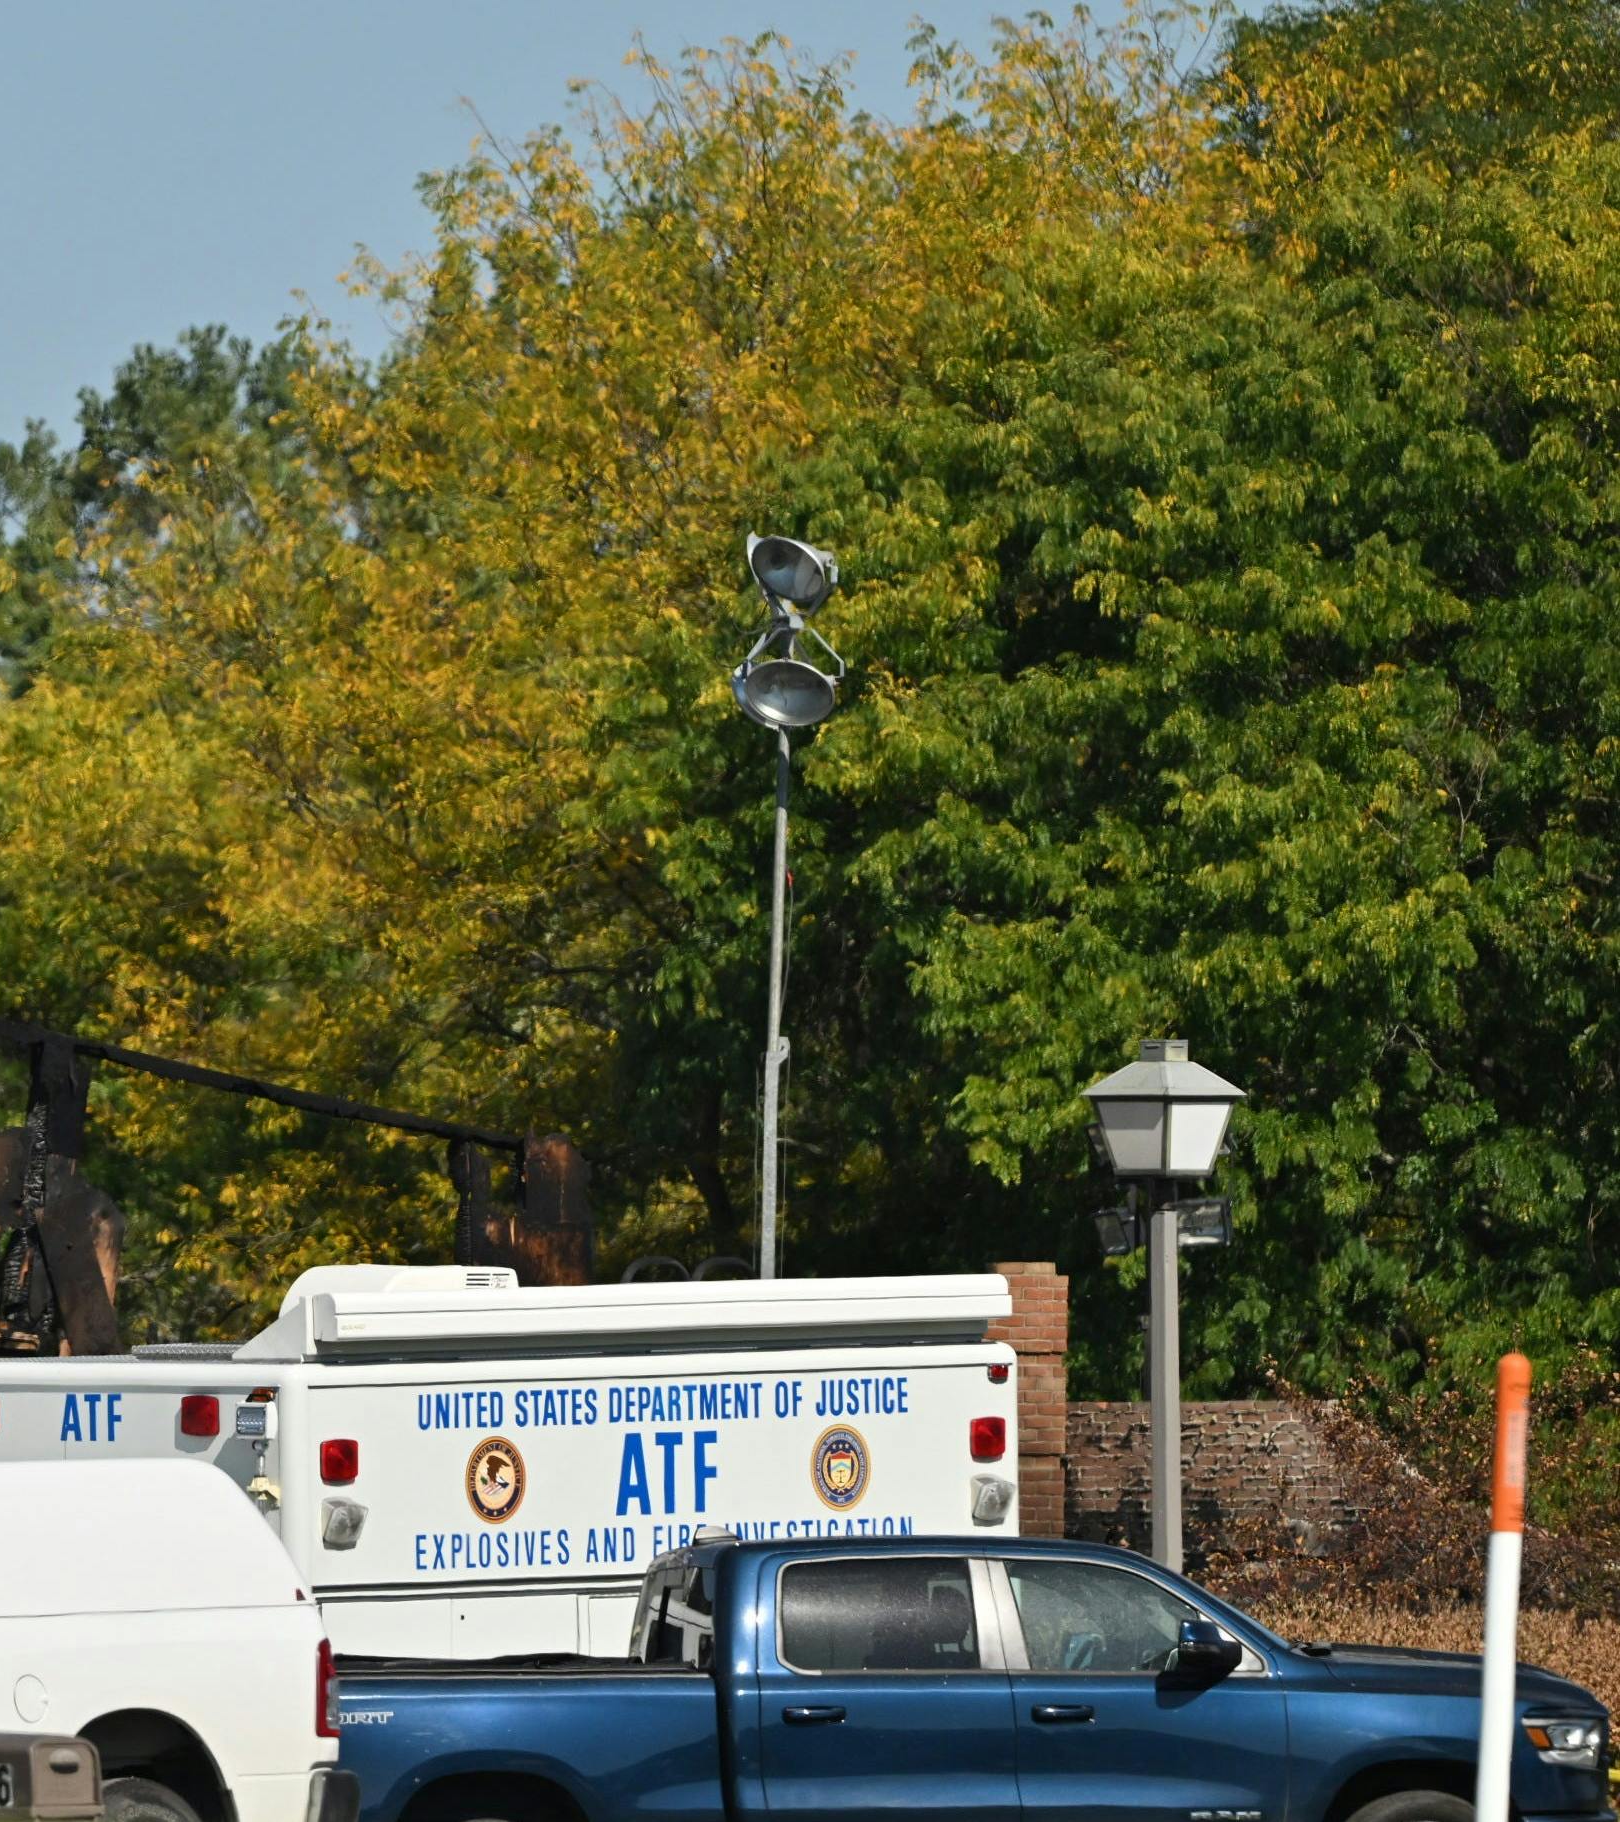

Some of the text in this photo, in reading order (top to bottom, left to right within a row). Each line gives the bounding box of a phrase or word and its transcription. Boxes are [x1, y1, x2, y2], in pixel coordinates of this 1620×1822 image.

[60, 1393, 122, 1441] ATF
[417, 1376, 909, 1430] UNITED STATES DEPARTMENT OF JUSTICE
[615, 1430, 718, 1516] ATF
[415, 1516, 913, 1570] EXPLOSIVES AND FIR NVSTIATION
